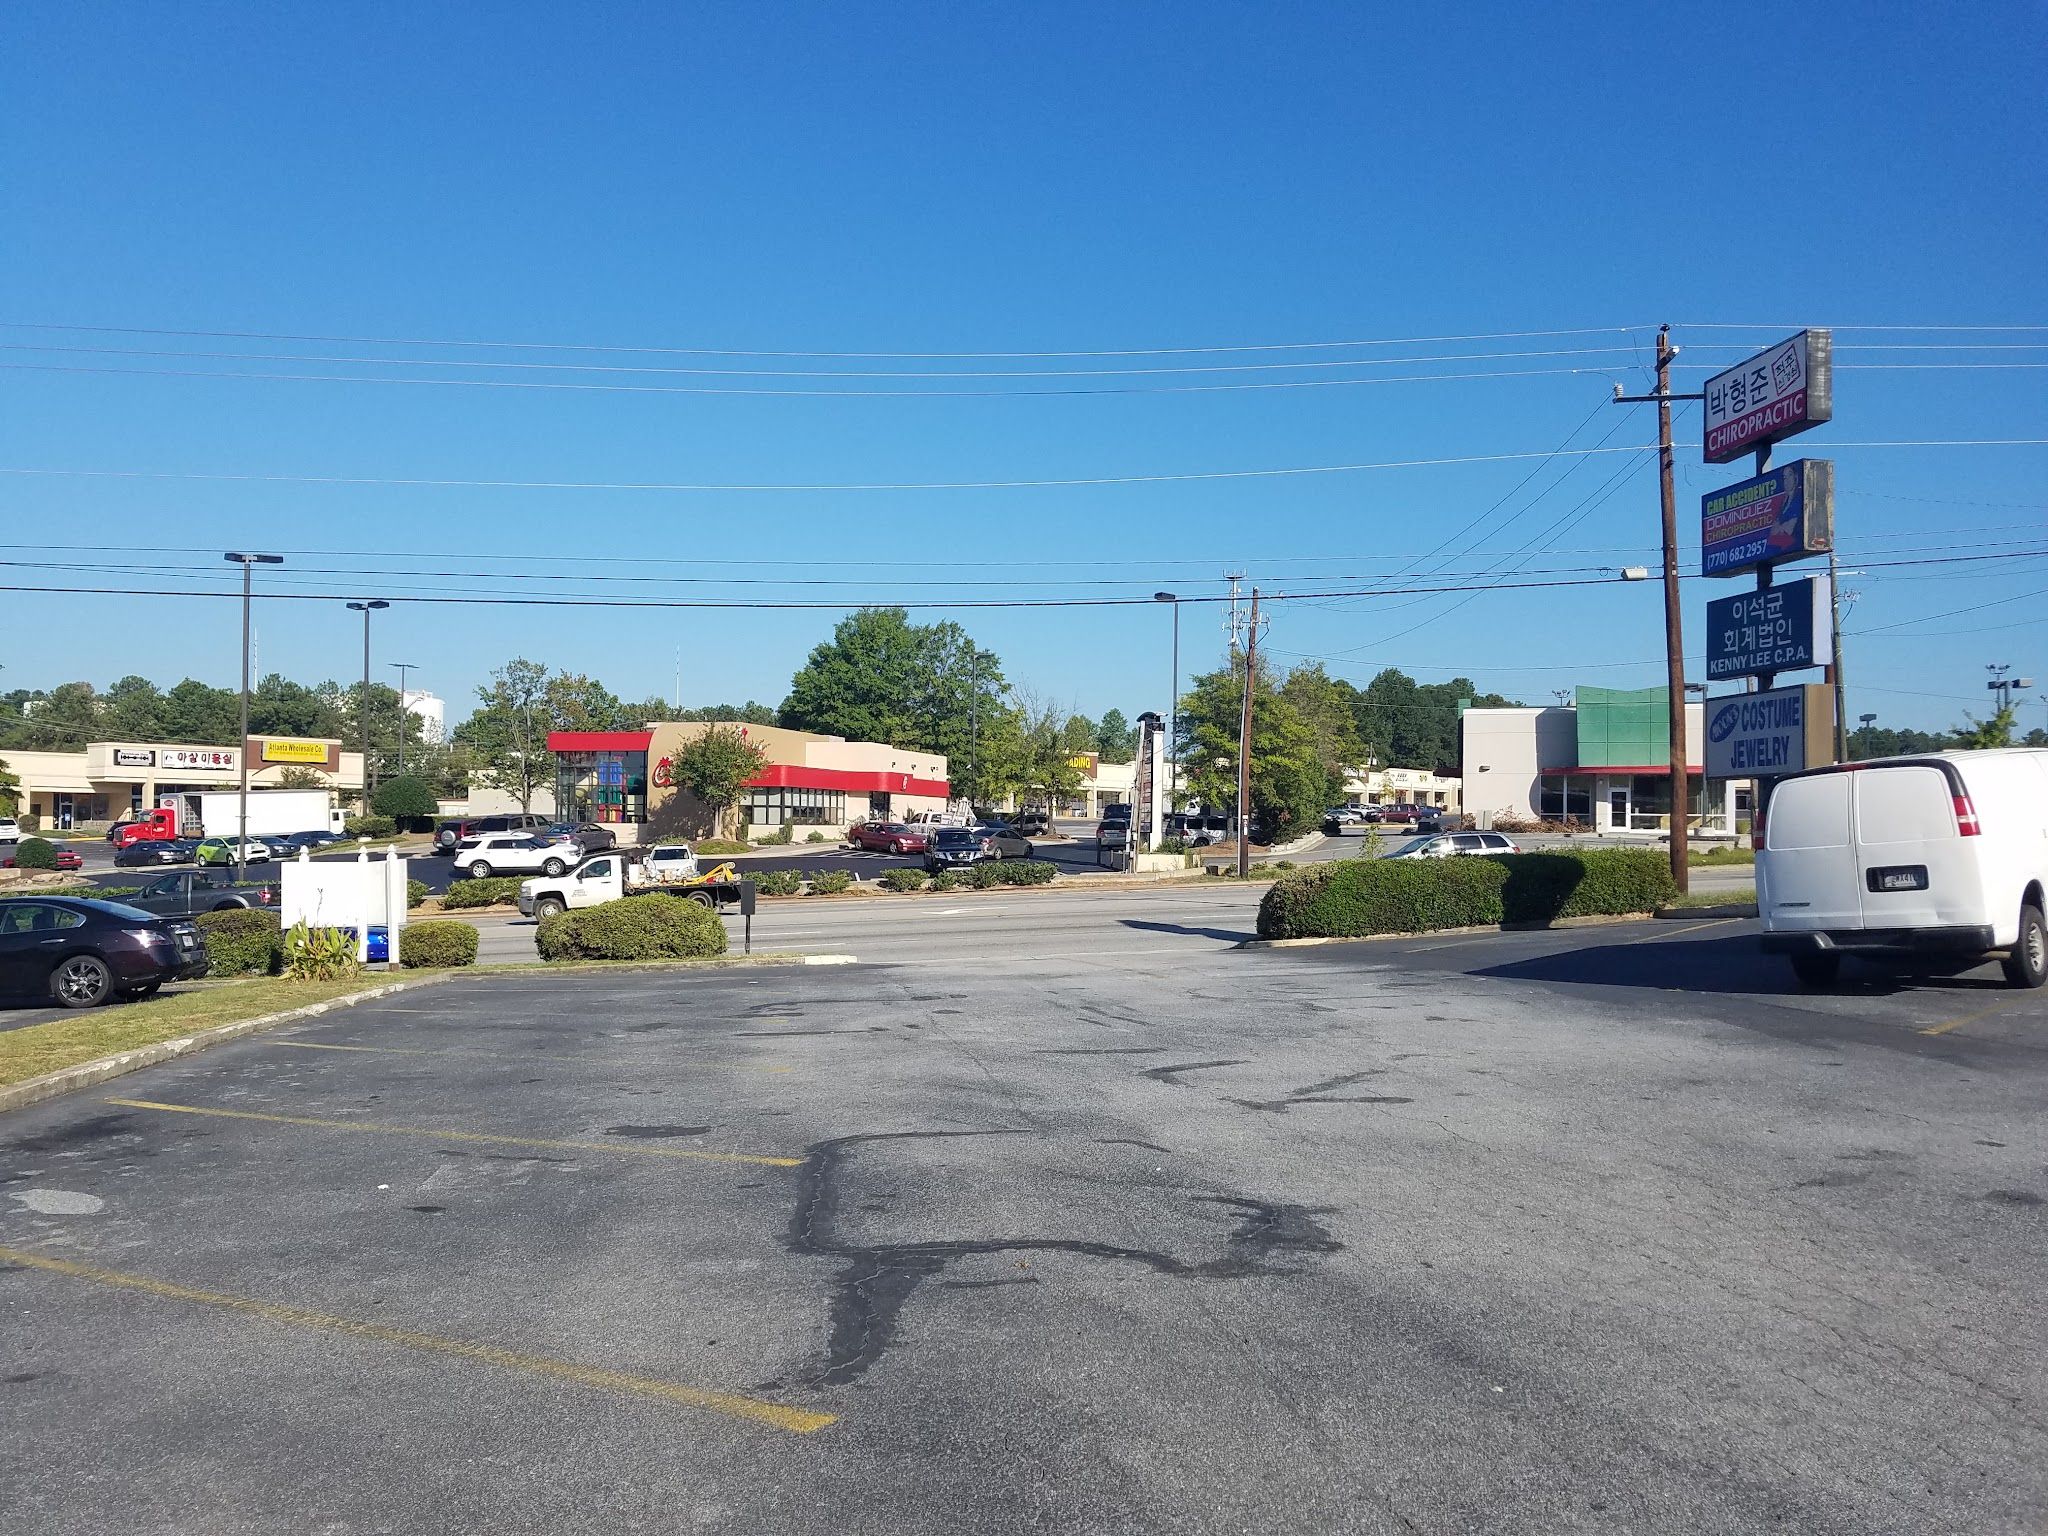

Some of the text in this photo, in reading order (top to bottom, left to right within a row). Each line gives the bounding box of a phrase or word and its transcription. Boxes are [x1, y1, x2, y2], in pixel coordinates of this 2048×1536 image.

[1710, 366, 1769, 420] 박형준
[1708, 393, 1803, 451] CHIROPRACTIC
[1707, 479, 1777, 516] CAR ACCIDENT?
[1706, 499, 1772, 531] DOMINGUEZ
[1706, 514, 1773, 543] CHIROPRACTIC
[1707, 539, 1768, 570] (770) 682 2957
[1732, 591, 1784, 625] 이석균
[1723, 618, 1792, 654] 회계법인
[1710, 645, 1809, 674] KENNY LEE C.P.A.
[1741, 696, 1800, 732] COSTUME
[1731, 735, 1790, 769] JEWELRY
